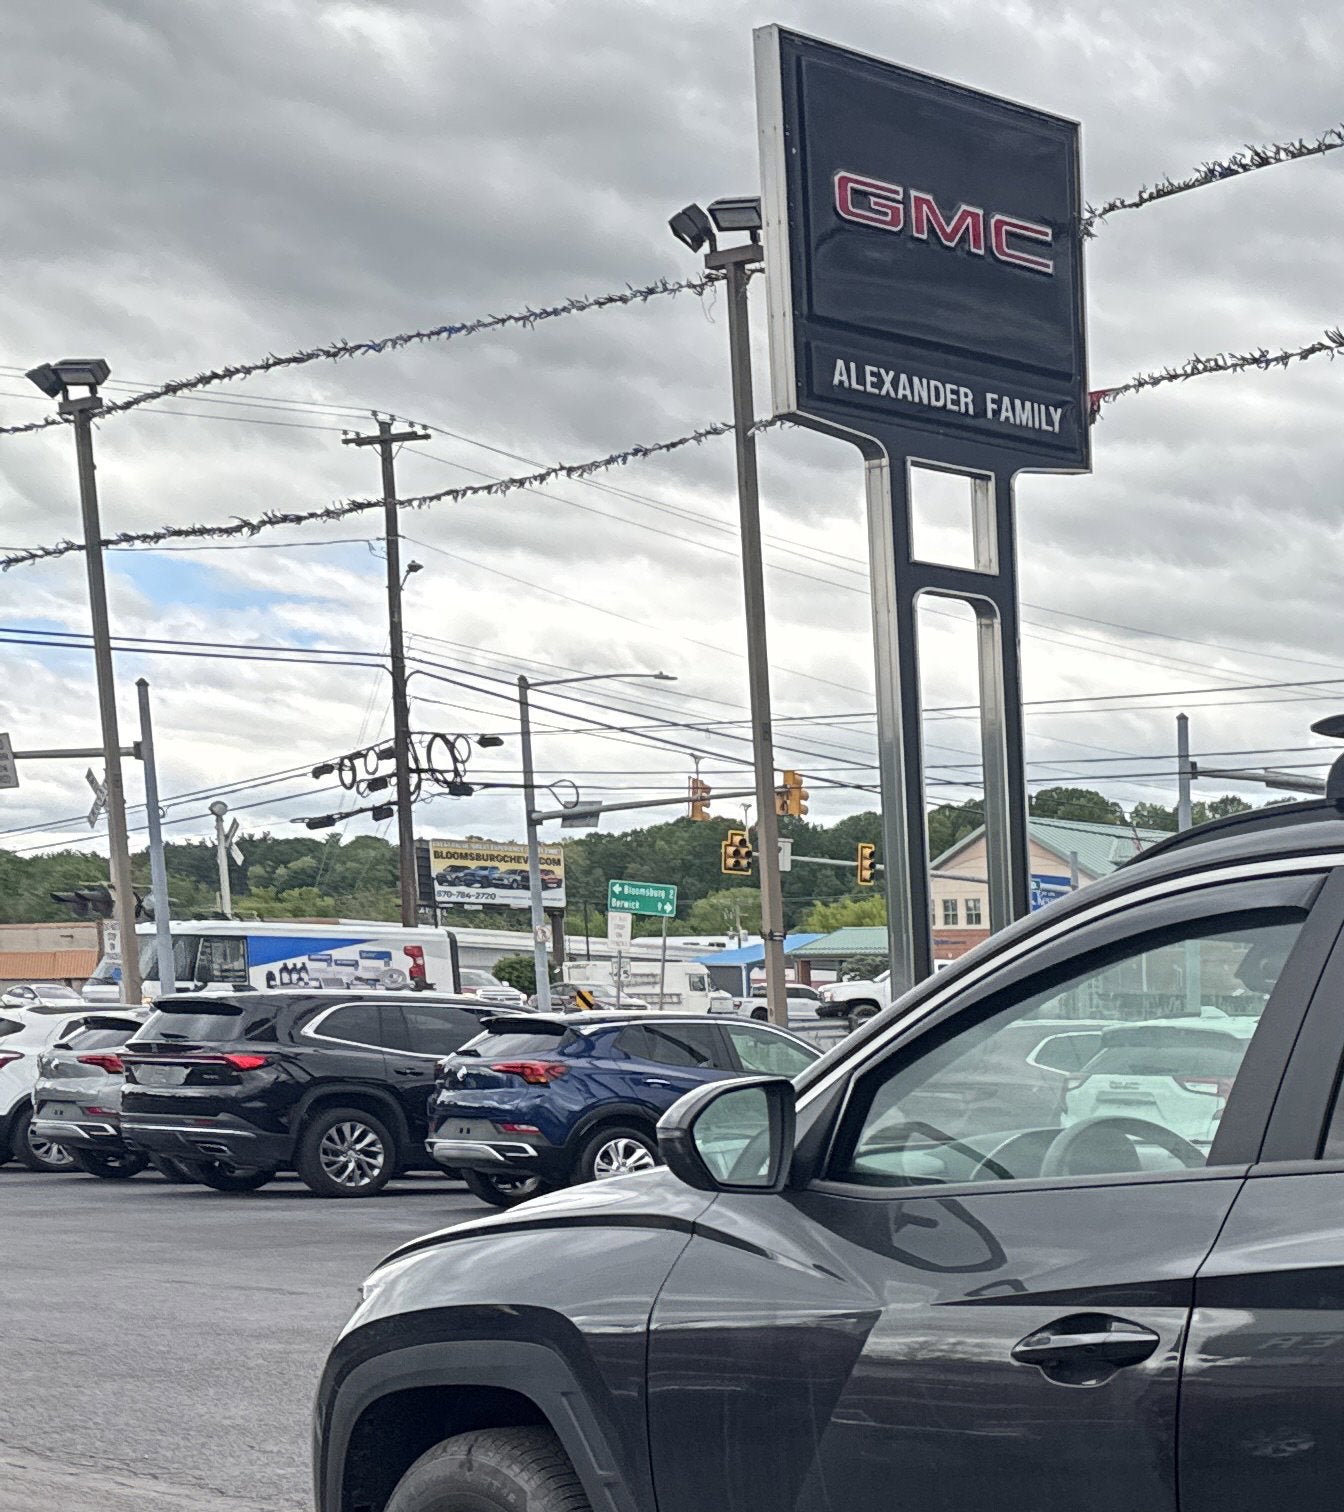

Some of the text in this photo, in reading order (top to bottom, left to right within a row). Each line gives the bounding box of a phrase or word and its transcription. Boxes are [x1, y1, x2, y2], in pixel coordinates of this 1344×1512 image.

[834, 170, 1054, 275] GMC
[832, 358, 1063, 434] ALEXANDER FAMILY
[433, 850, 562, 867] BLOOMSBURGCHEVCOM
[623, 885, 666, 900] Bloomsburg
[611, 897, 640, 910] Berwick
